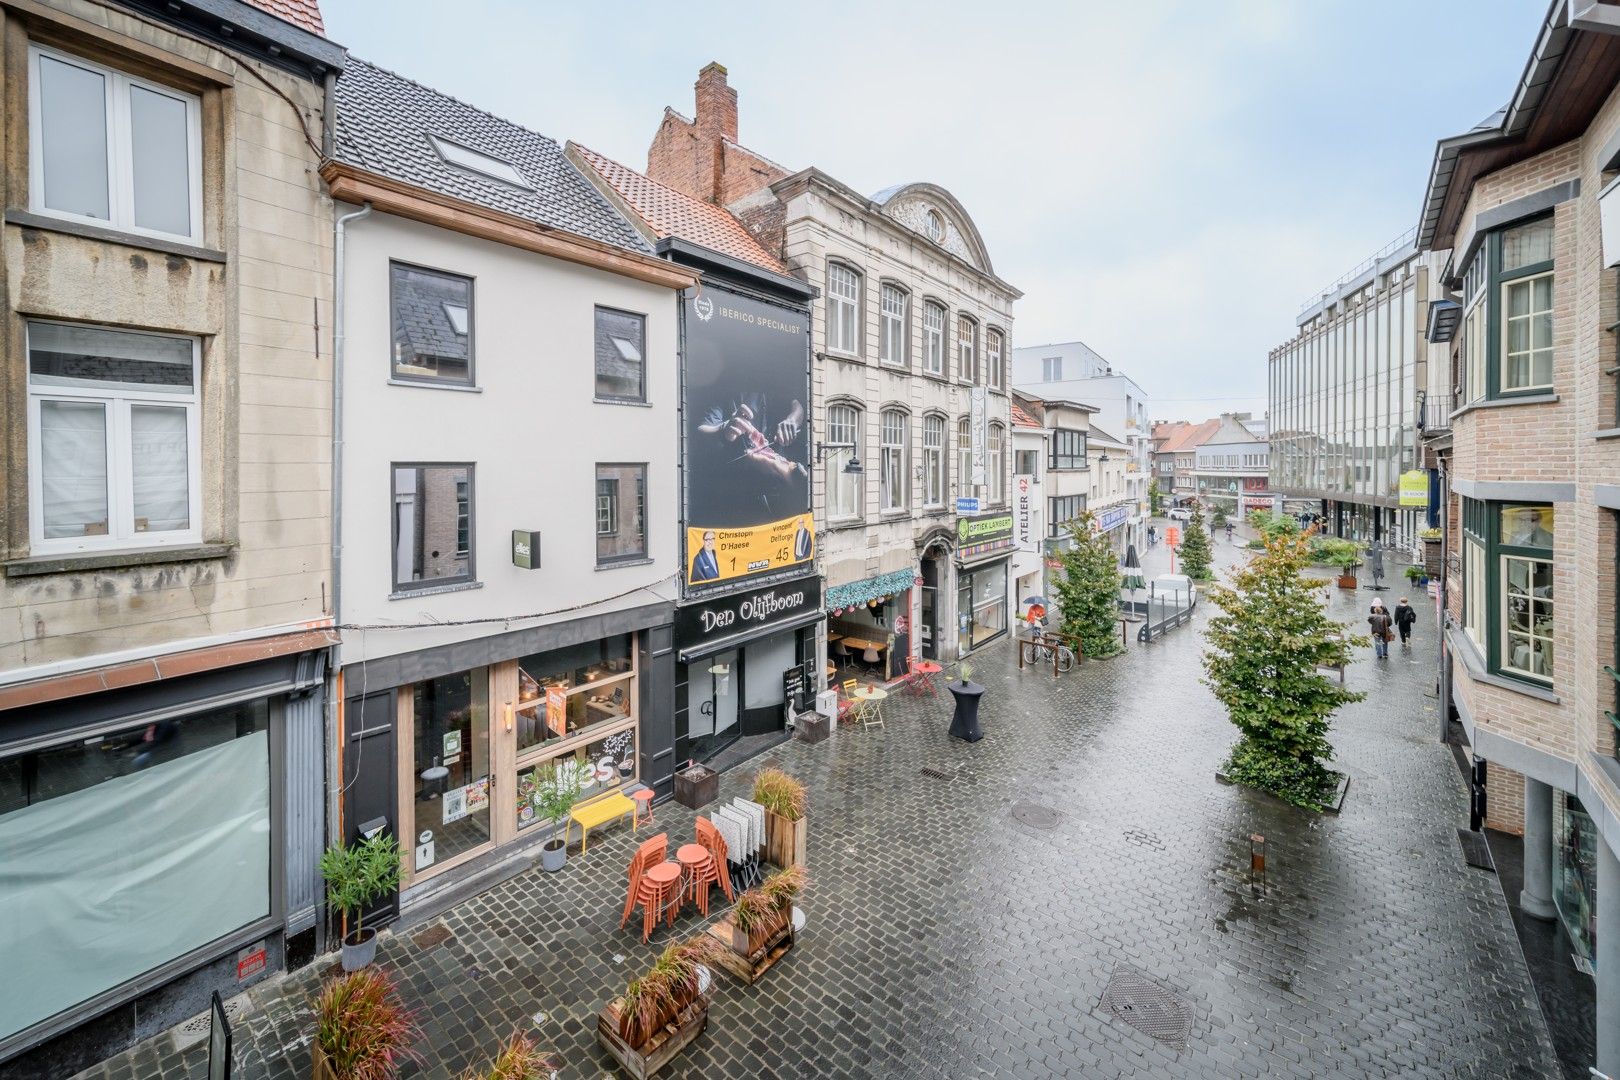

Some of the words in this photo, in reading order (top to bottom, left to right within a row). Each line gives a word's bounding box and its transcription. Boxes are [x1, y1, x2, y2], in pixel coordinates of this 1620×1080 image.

[719, 307, 754, 323] IBERICO
[757, 317, 801, 334] SPECIALIST
[1019, 478, 1028, 492] 42
[773, 522, 793, 532] Vincent
[969, 523, 989, 533] OPTIEK
[989, 518, 1011, 529] LAMBERT
[1020, 495, 1029, 544] ATELIER
[718, 530, 754, 540] Christoph
[720, 541, 750, 551] D'Haese
[775, 546, 789, 562] 45
[729, 556, 737, 572] 1
[700, 610, 735, 633] Den
[740, 591, 804, 621] Olijfboom
